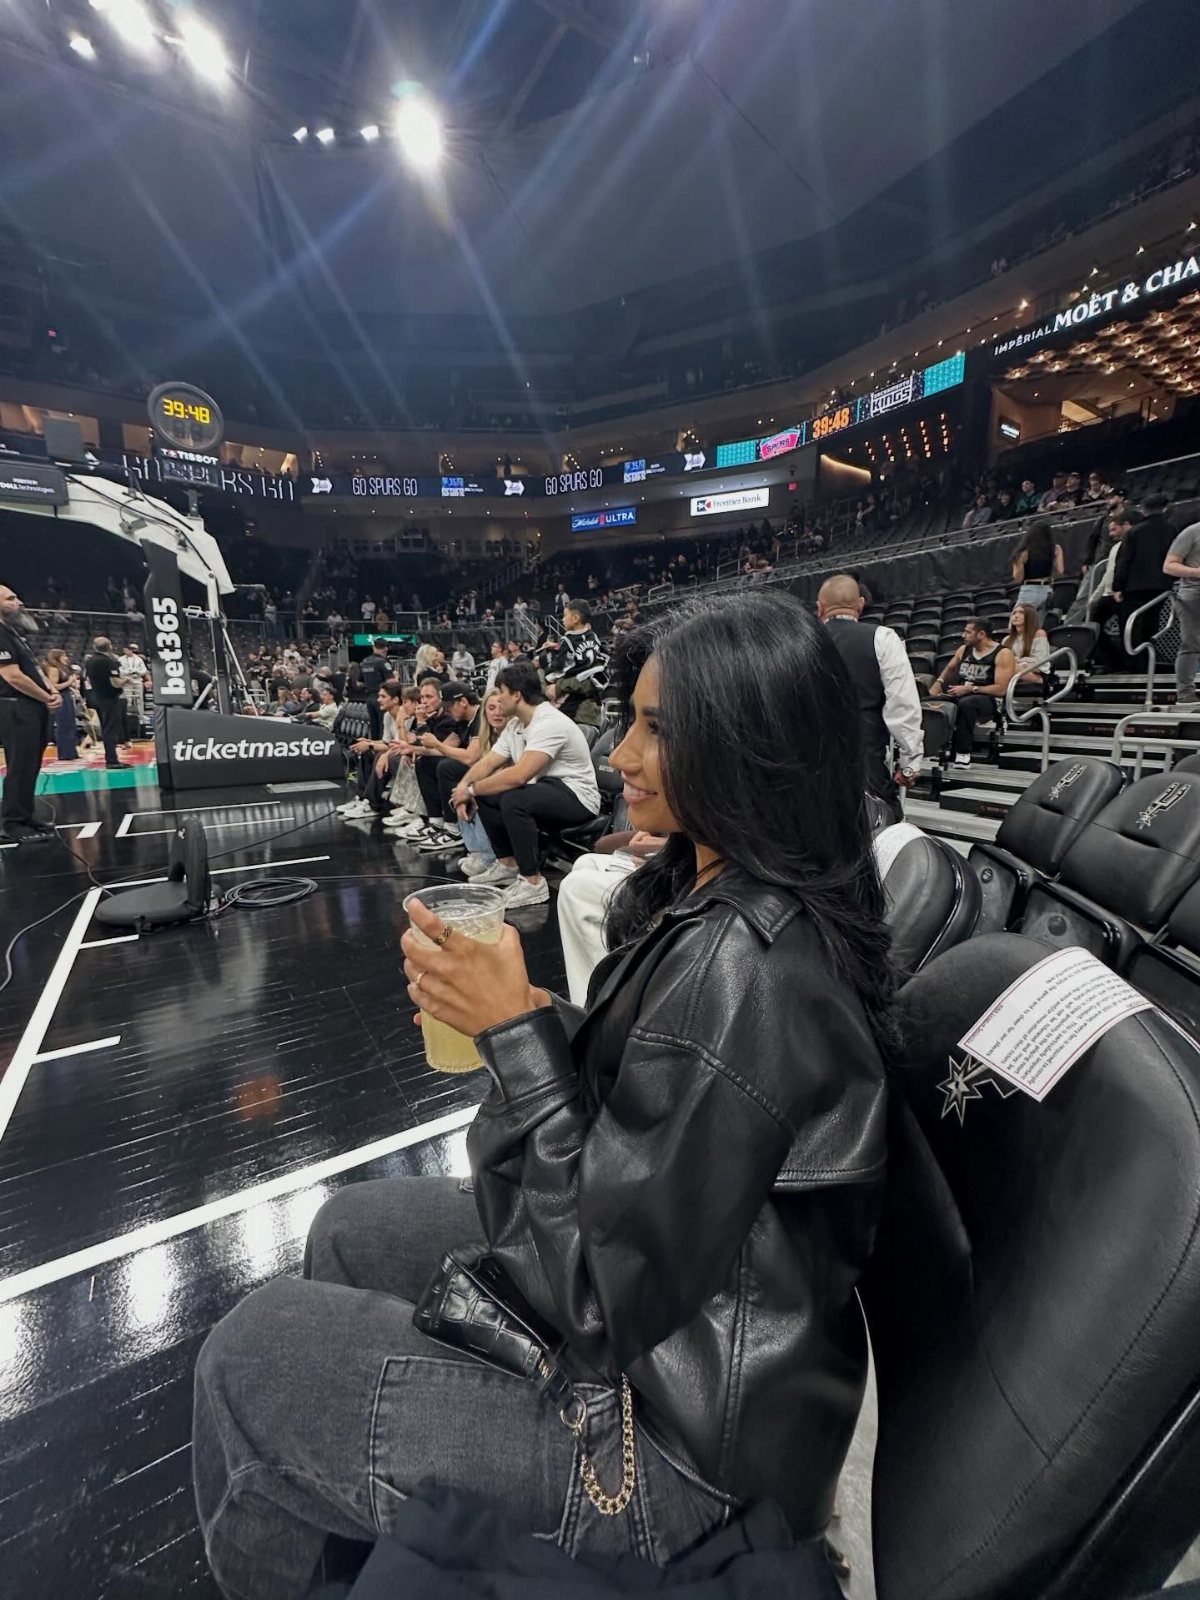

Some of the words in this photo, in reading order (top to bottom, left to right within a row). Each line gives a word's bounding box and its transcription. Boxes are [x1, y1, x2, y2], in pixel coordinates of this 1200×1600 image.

[1053, 289, 1119, 331] MOËT
[1122, 282, 1140, 304] &
[162, 399, 210, 424] 39:48
[872, 388, 910, 411] KINGS
[812, 406, 850, 438] 39:48
[177, 450, 218, 465] TISSOT
[352, 477, 367, 496] GO
[369, 477, 401, 496] SPURS
[403, 477, 418, 496] GO
[545, 477, 558, 495] GO
[559, 470, 588, 493] SPURS
[589, 468, 603, 488] GO
[713, 499, 741, 508] Frontier
[742, 493, 762, 504] Bank
[605, 512, 634, 523] ULTRA
[152, 597, 186, 695] bet365
[173, 737, 336, 761] ticketmaster
